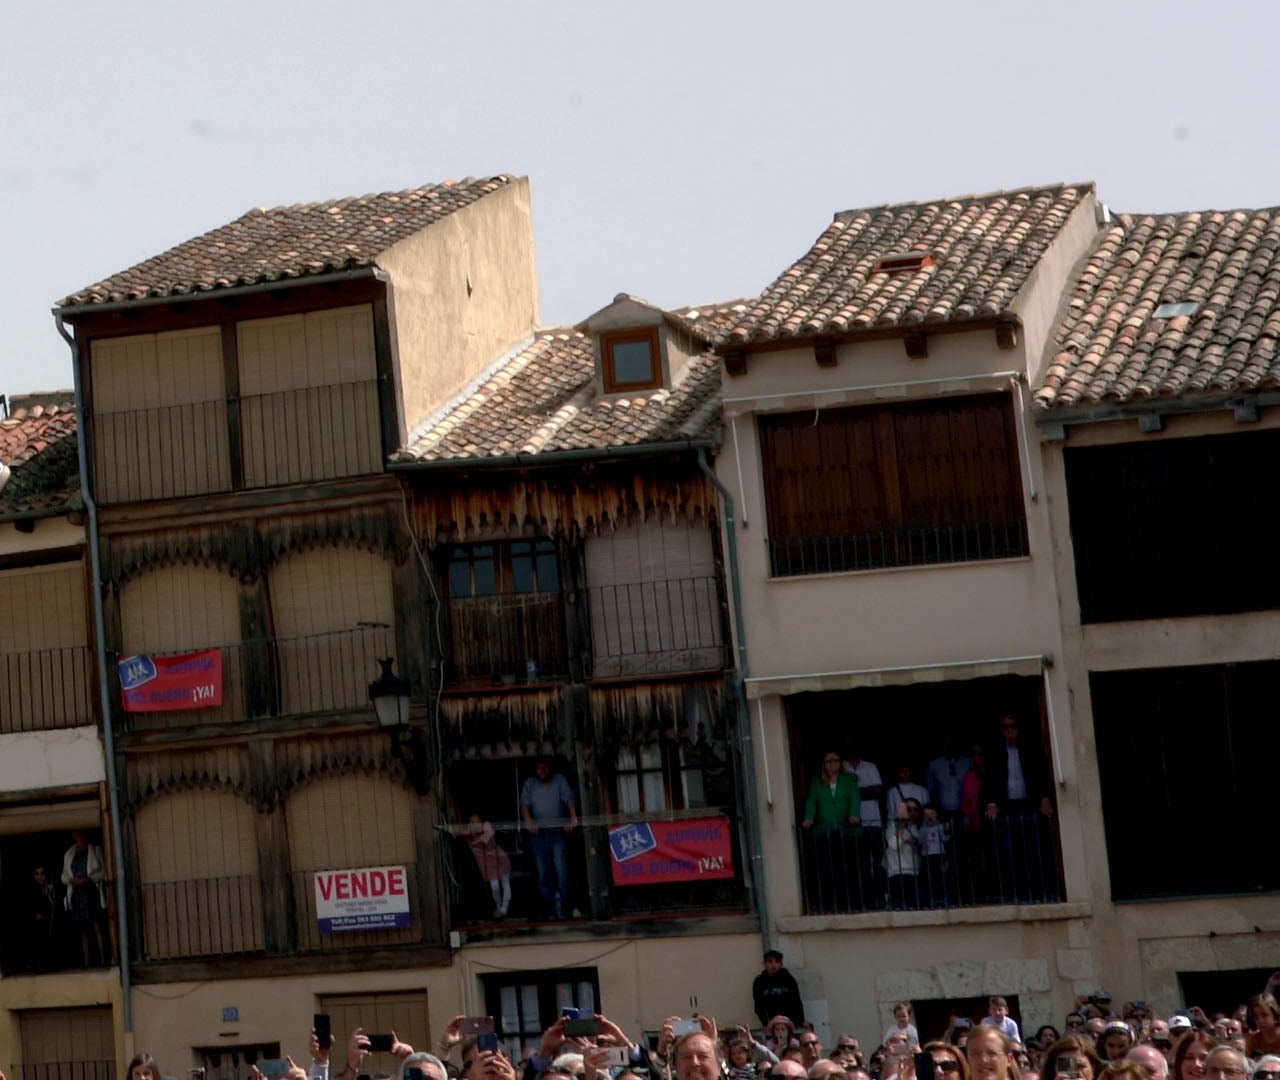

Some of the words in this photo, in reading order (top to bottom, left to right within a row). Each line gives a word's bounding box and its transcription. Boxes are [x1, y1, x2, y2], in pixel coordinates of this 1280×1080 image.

[193, 684, 215, 703] ¡YA!
[698, 855, 725, 874] ¡YA!
[317, 870, 404, 900] VENDE
